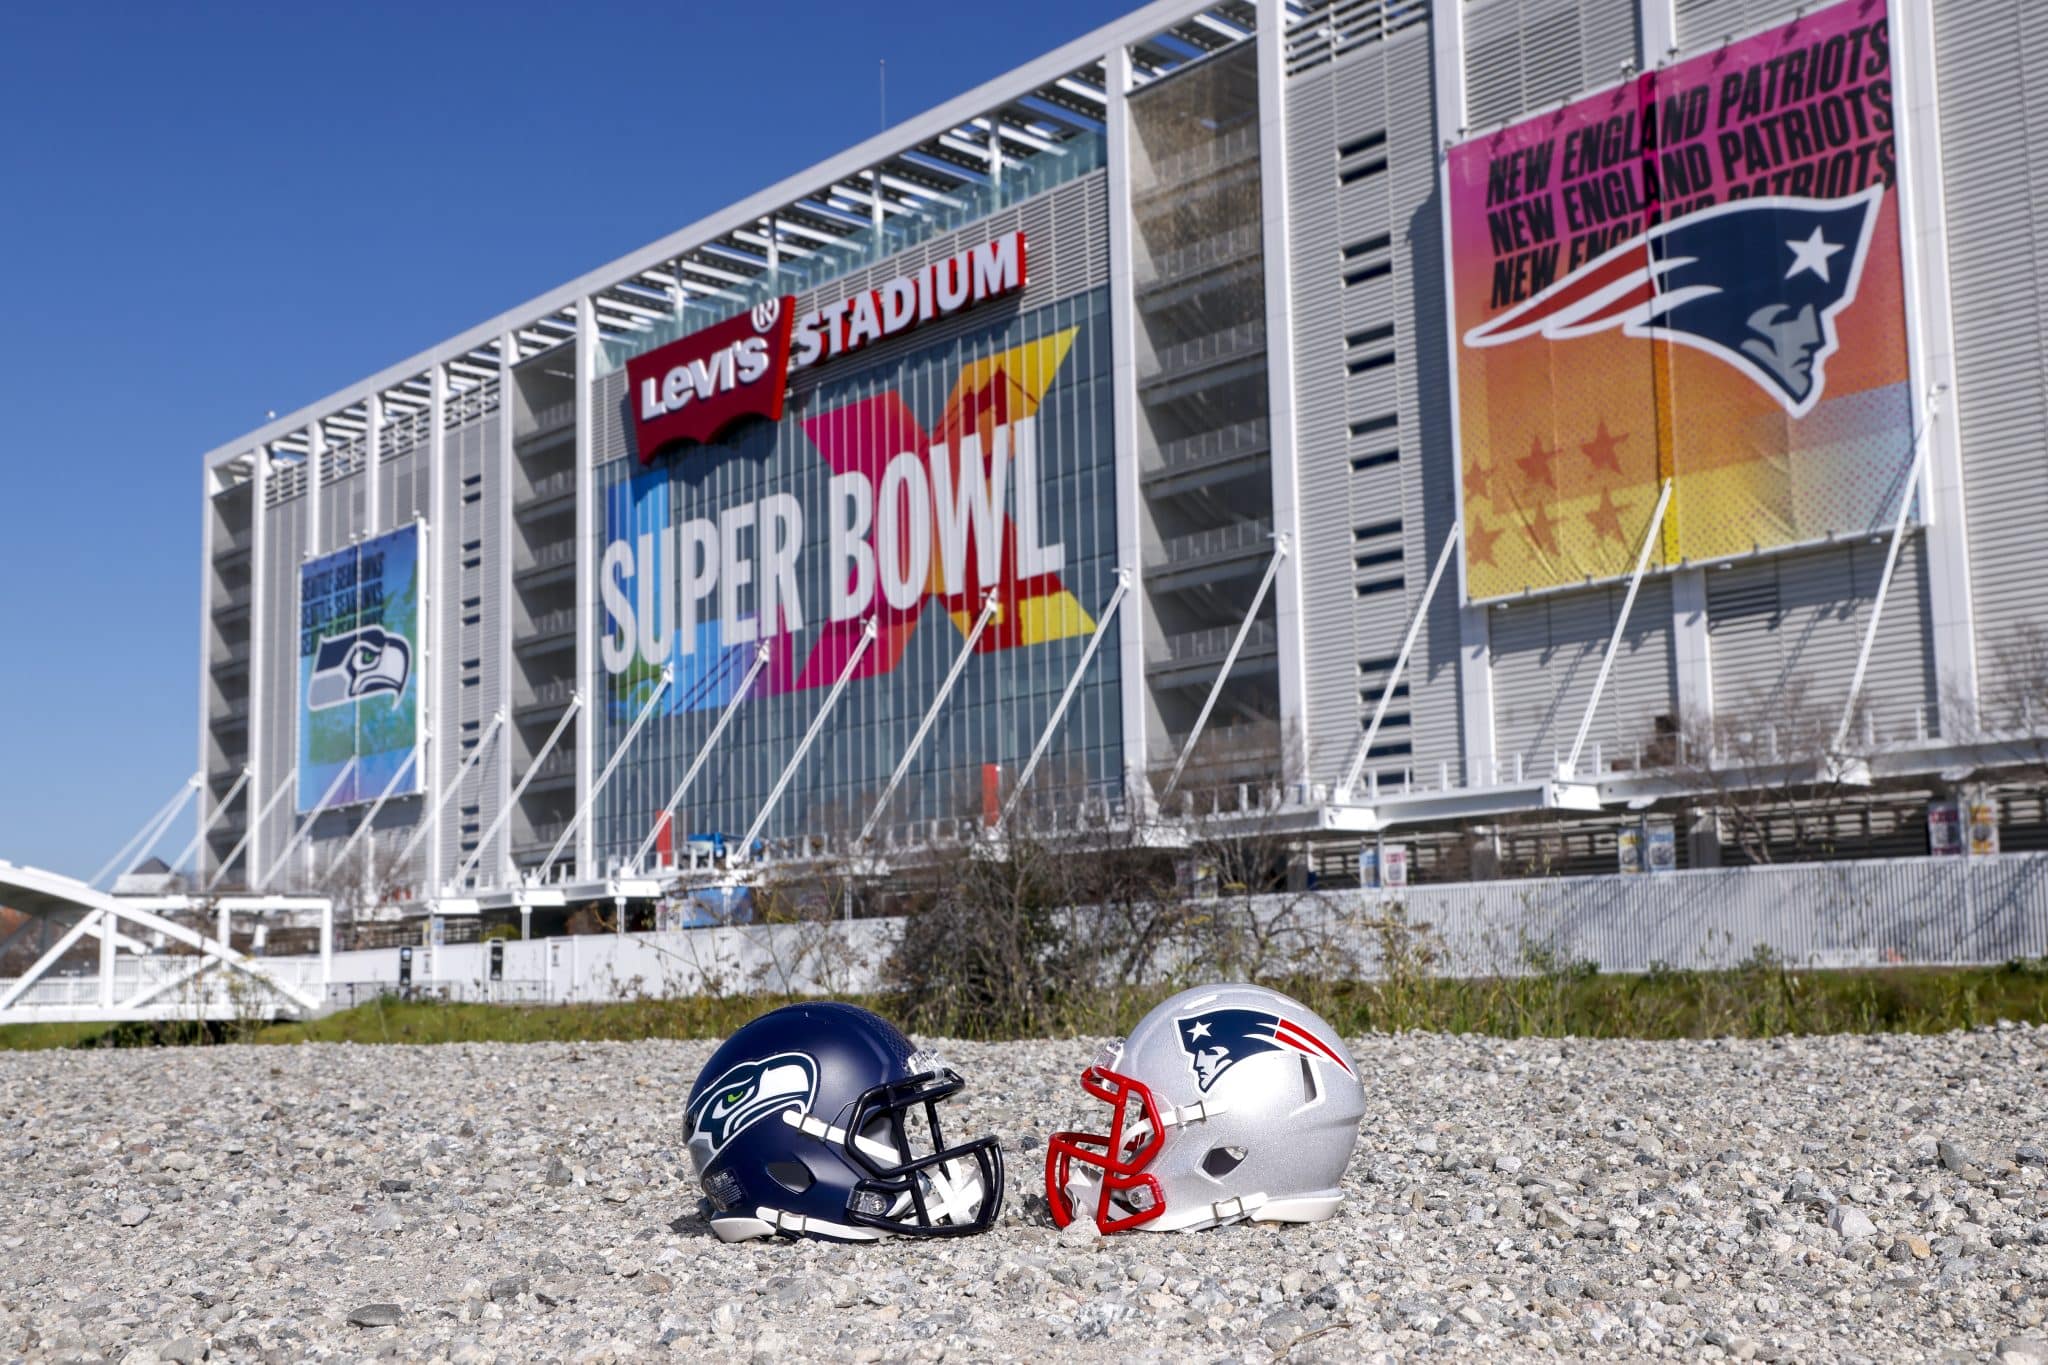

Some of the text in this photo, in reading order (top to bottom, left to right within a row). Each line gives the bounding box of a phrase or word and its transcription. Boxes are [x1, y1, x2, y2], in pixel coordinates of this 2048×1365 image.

[1486, 17, 1889, 209] NEW ENGLAND PATRIOTS
[1487, 193, 1556, 256] NEW
[1561, 143, 1713, 232] ENGLAND
[1717, 80, 1893, 182] PATRIOTS
[797, 231, 1024, 367] STADIUM
[1490, 243, 1561, 309] NEW
[600, 416, 1066, 675] SUPER BOWL
